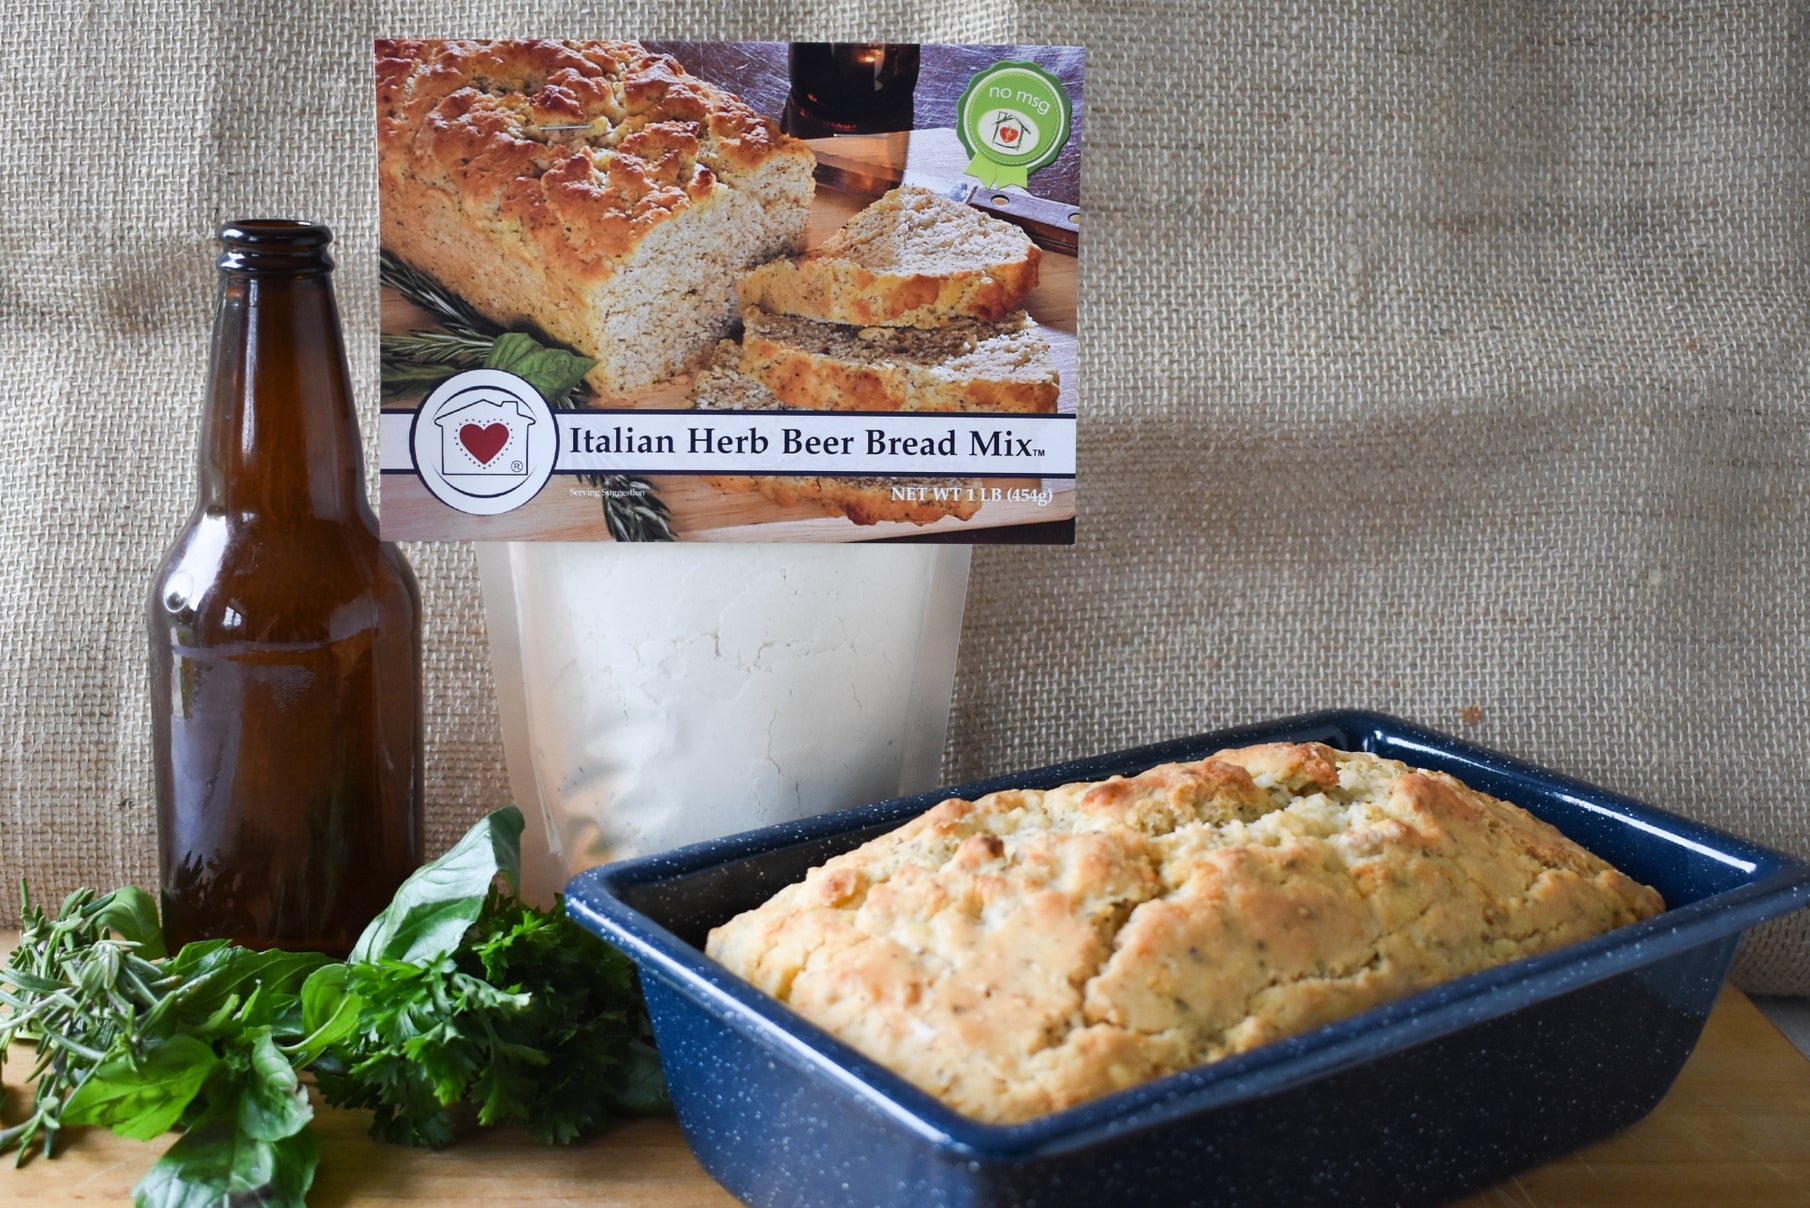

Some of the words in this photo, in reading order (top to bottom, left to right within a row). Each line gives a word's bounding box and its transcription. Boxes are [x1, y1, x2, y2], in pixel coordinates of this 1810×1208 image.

[989, 86, 1012, 99] no
[1016, 91, 1051, 115] msg
[569, 426, 676, 454] Italian
[687, 427, 769, 455] Herb
[782, 428, 854, 455] Beer
[865, 428, 957, 456] Bread
[569, 488, 600, 499] Serving
[601, 488, 645, 499] Suggestion
[891, 487, 925, 502] NET
[933, 487, 961, 502] WT
[967, 488, 974, 502] 1
[981, 488, 1002, 502] LB
[1007, 488, 1054, 506] (454g)
